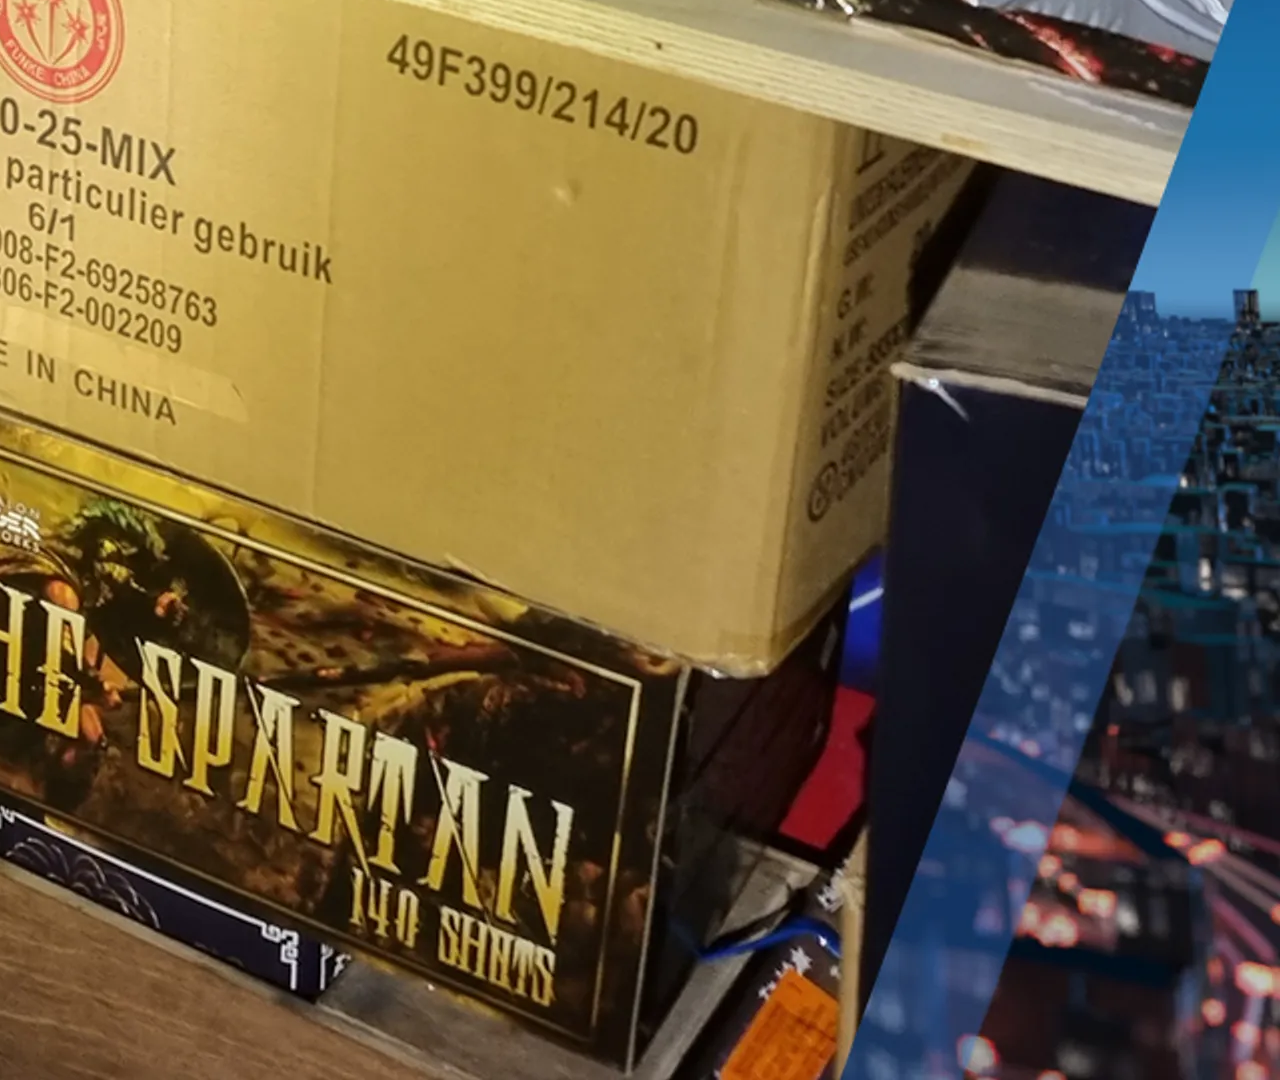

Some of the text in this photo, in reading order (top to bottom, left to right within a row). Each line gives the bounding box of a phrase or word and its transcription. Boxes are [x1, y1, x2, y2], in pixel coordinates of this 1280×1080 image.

[387, 33, 700, 156] 49F399/214/20
[6, 154, 184, 235] particulier
[193, 215, 333, 284] gebruik
[27, 202, 76, 242] 6/1
[25, 349, 56, 384] IN
[74, 368, 178, 426] CHINA
[135, 636, 574, 946] SPARTAN
[349, 867, 556, 1008] 140 SHOTS
